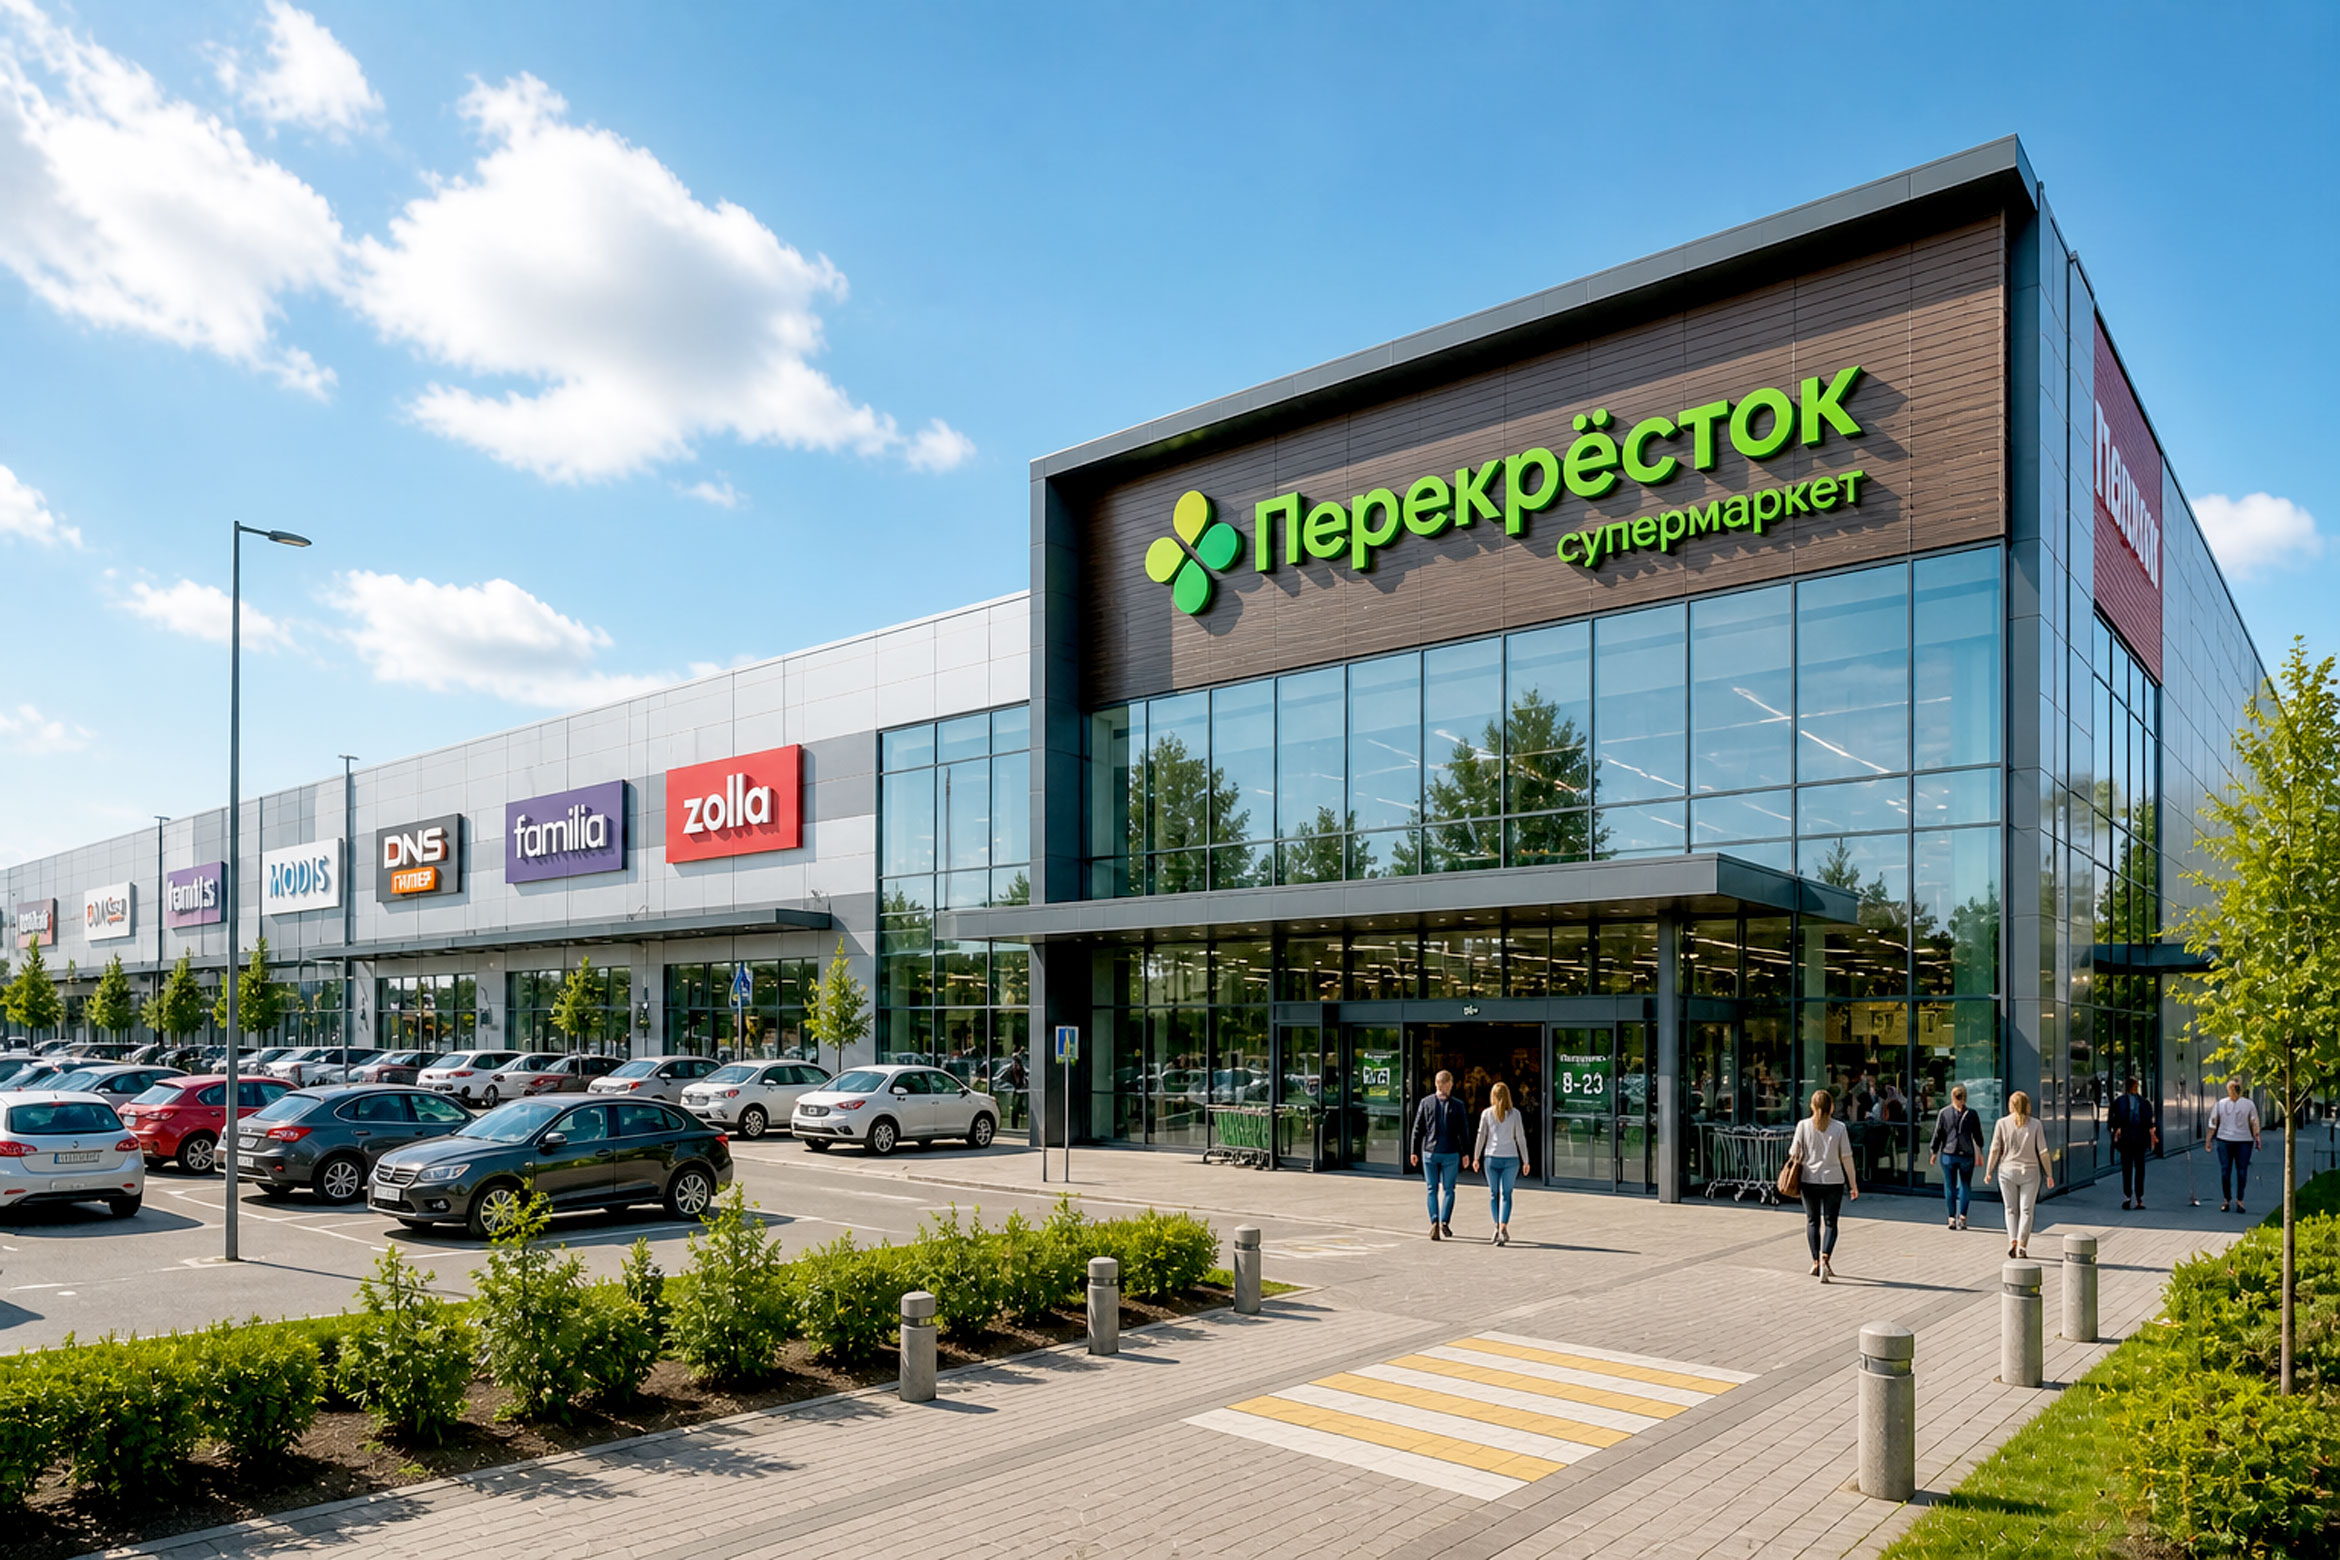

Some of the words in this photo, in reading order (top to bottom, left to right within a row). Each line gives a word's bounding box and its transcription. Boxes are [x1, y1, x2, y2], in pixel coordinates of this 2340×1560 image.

[1255, 364, 1866, 574] Перекрёсток
[1556, 469, 1866, 568] супермаркет
[513, 803, 607, 859] familia
[683, 772, 771, 834] zolla
[384, 827, 447, 869] DNS
